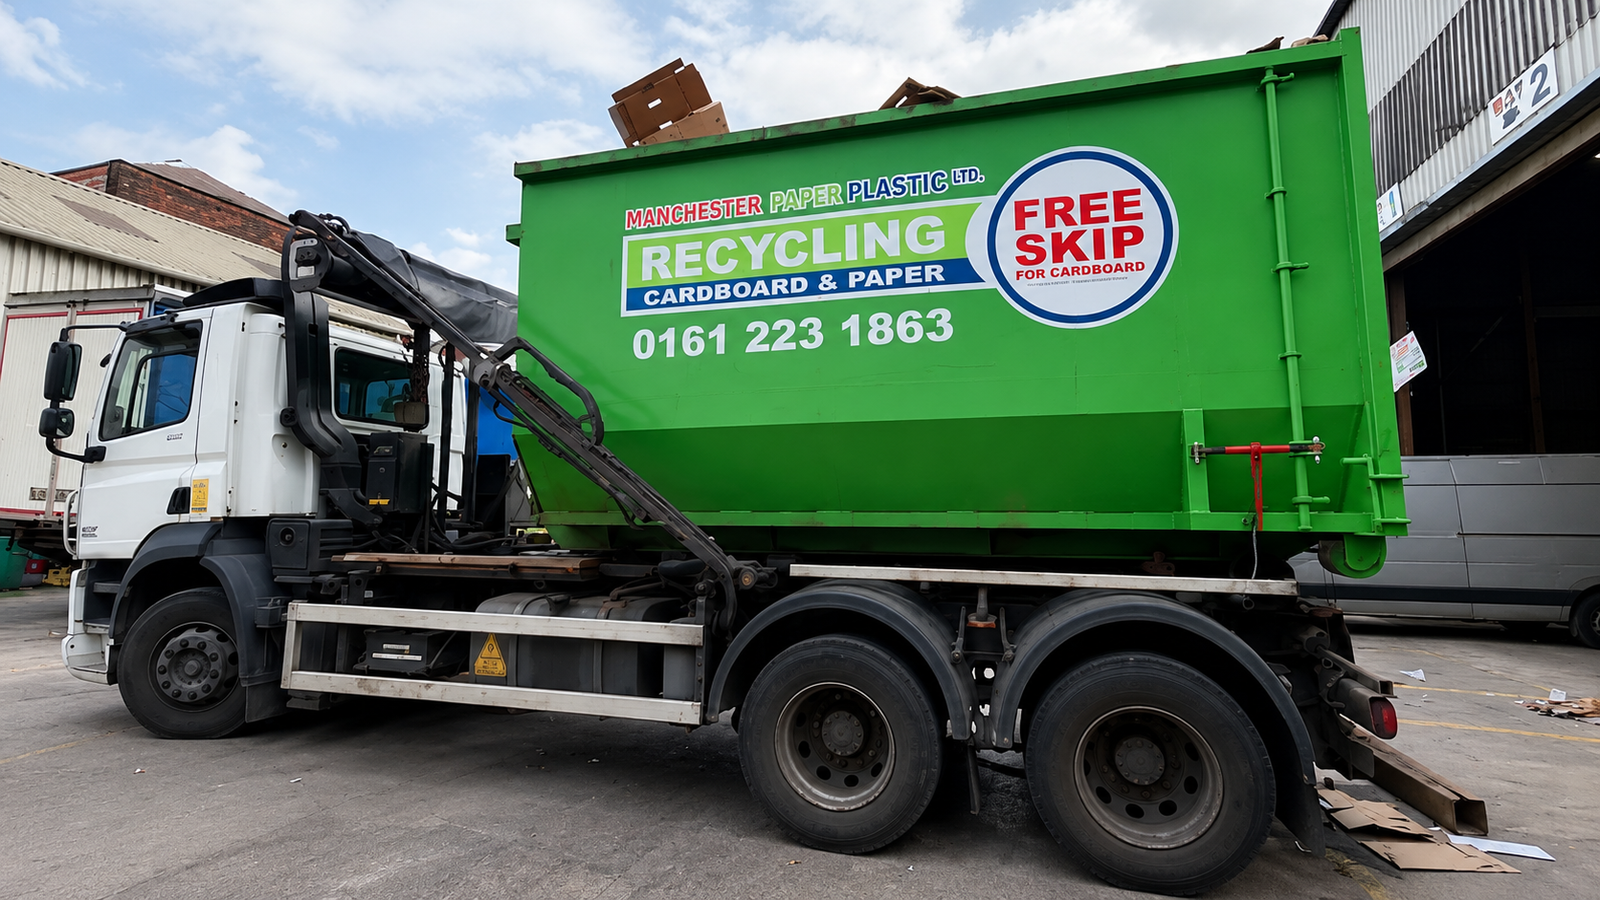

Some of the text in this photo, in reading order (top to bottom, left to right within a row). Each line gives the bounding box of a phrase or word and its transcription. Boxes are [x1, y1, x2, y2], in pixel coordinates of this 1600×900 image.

[1530, 63, 1551, 107] 2
[625, 167, 985, 230] MANCHESTER PAPER PLASTIC LTD.
[1014, 188, 1144, 231] FREE
[641, 215, 945, 281] RECYCLING
[1015, 225, 1145, 266] SKIP
[643, 264, 945, 306] CARDBOARD & PAPER
[1016, 261, 1146, 281] FOR CARDBOARD
[632, 307, 954, 360] 0161 223 1863
